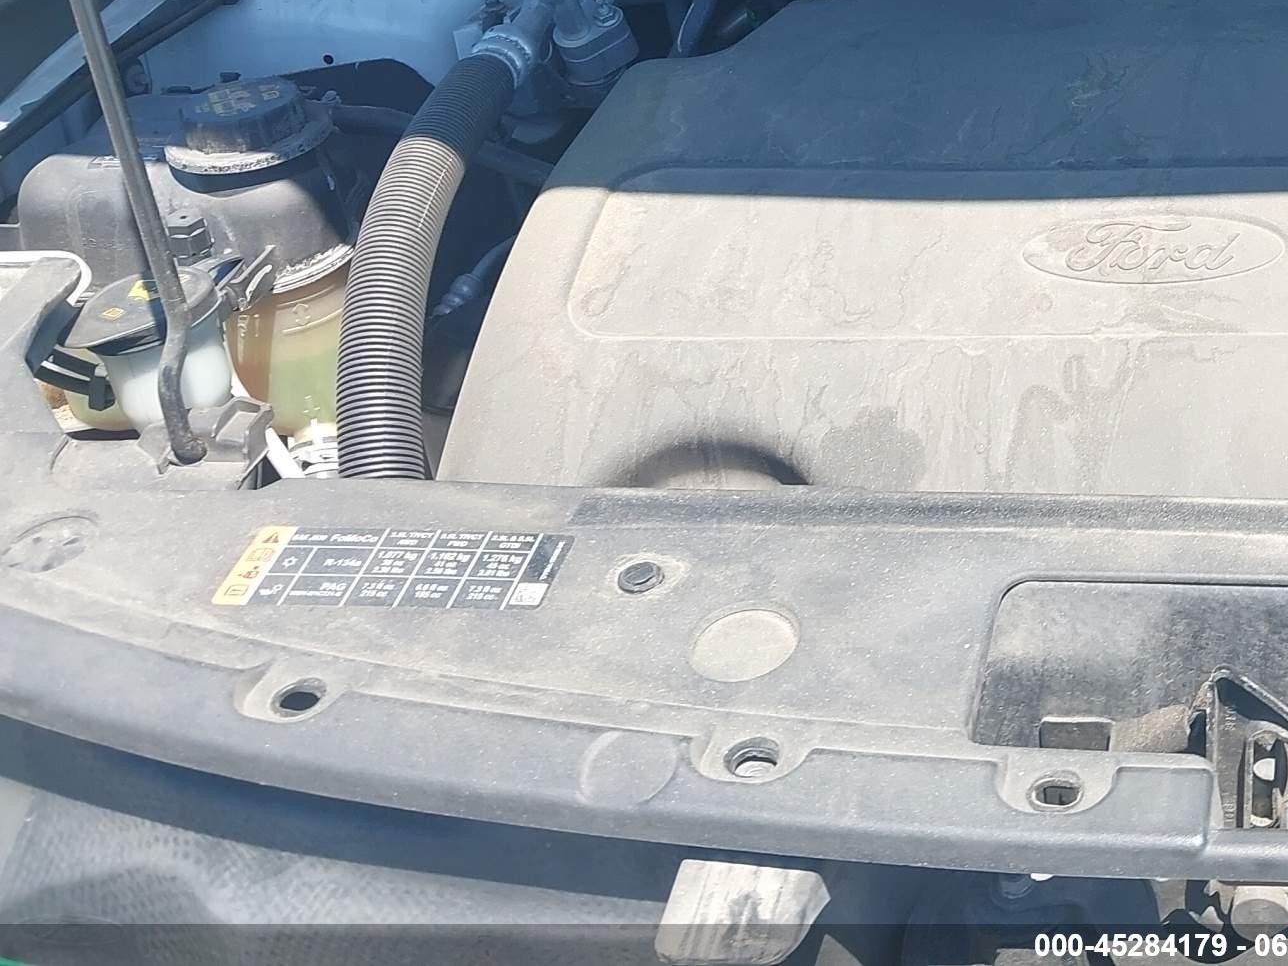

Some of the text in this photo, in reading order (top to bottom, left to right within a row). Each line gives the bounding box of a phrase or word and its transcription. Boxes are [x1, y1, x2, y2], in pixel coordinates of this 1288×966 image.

[1066, 219, 1241, 272] Ford
[330, 533, 379, 543] FoMoCo
[402, 551, 419, 561] kg
[323, 558, 362, 567] R-134a
[319, 581, 347, 592] PAG
